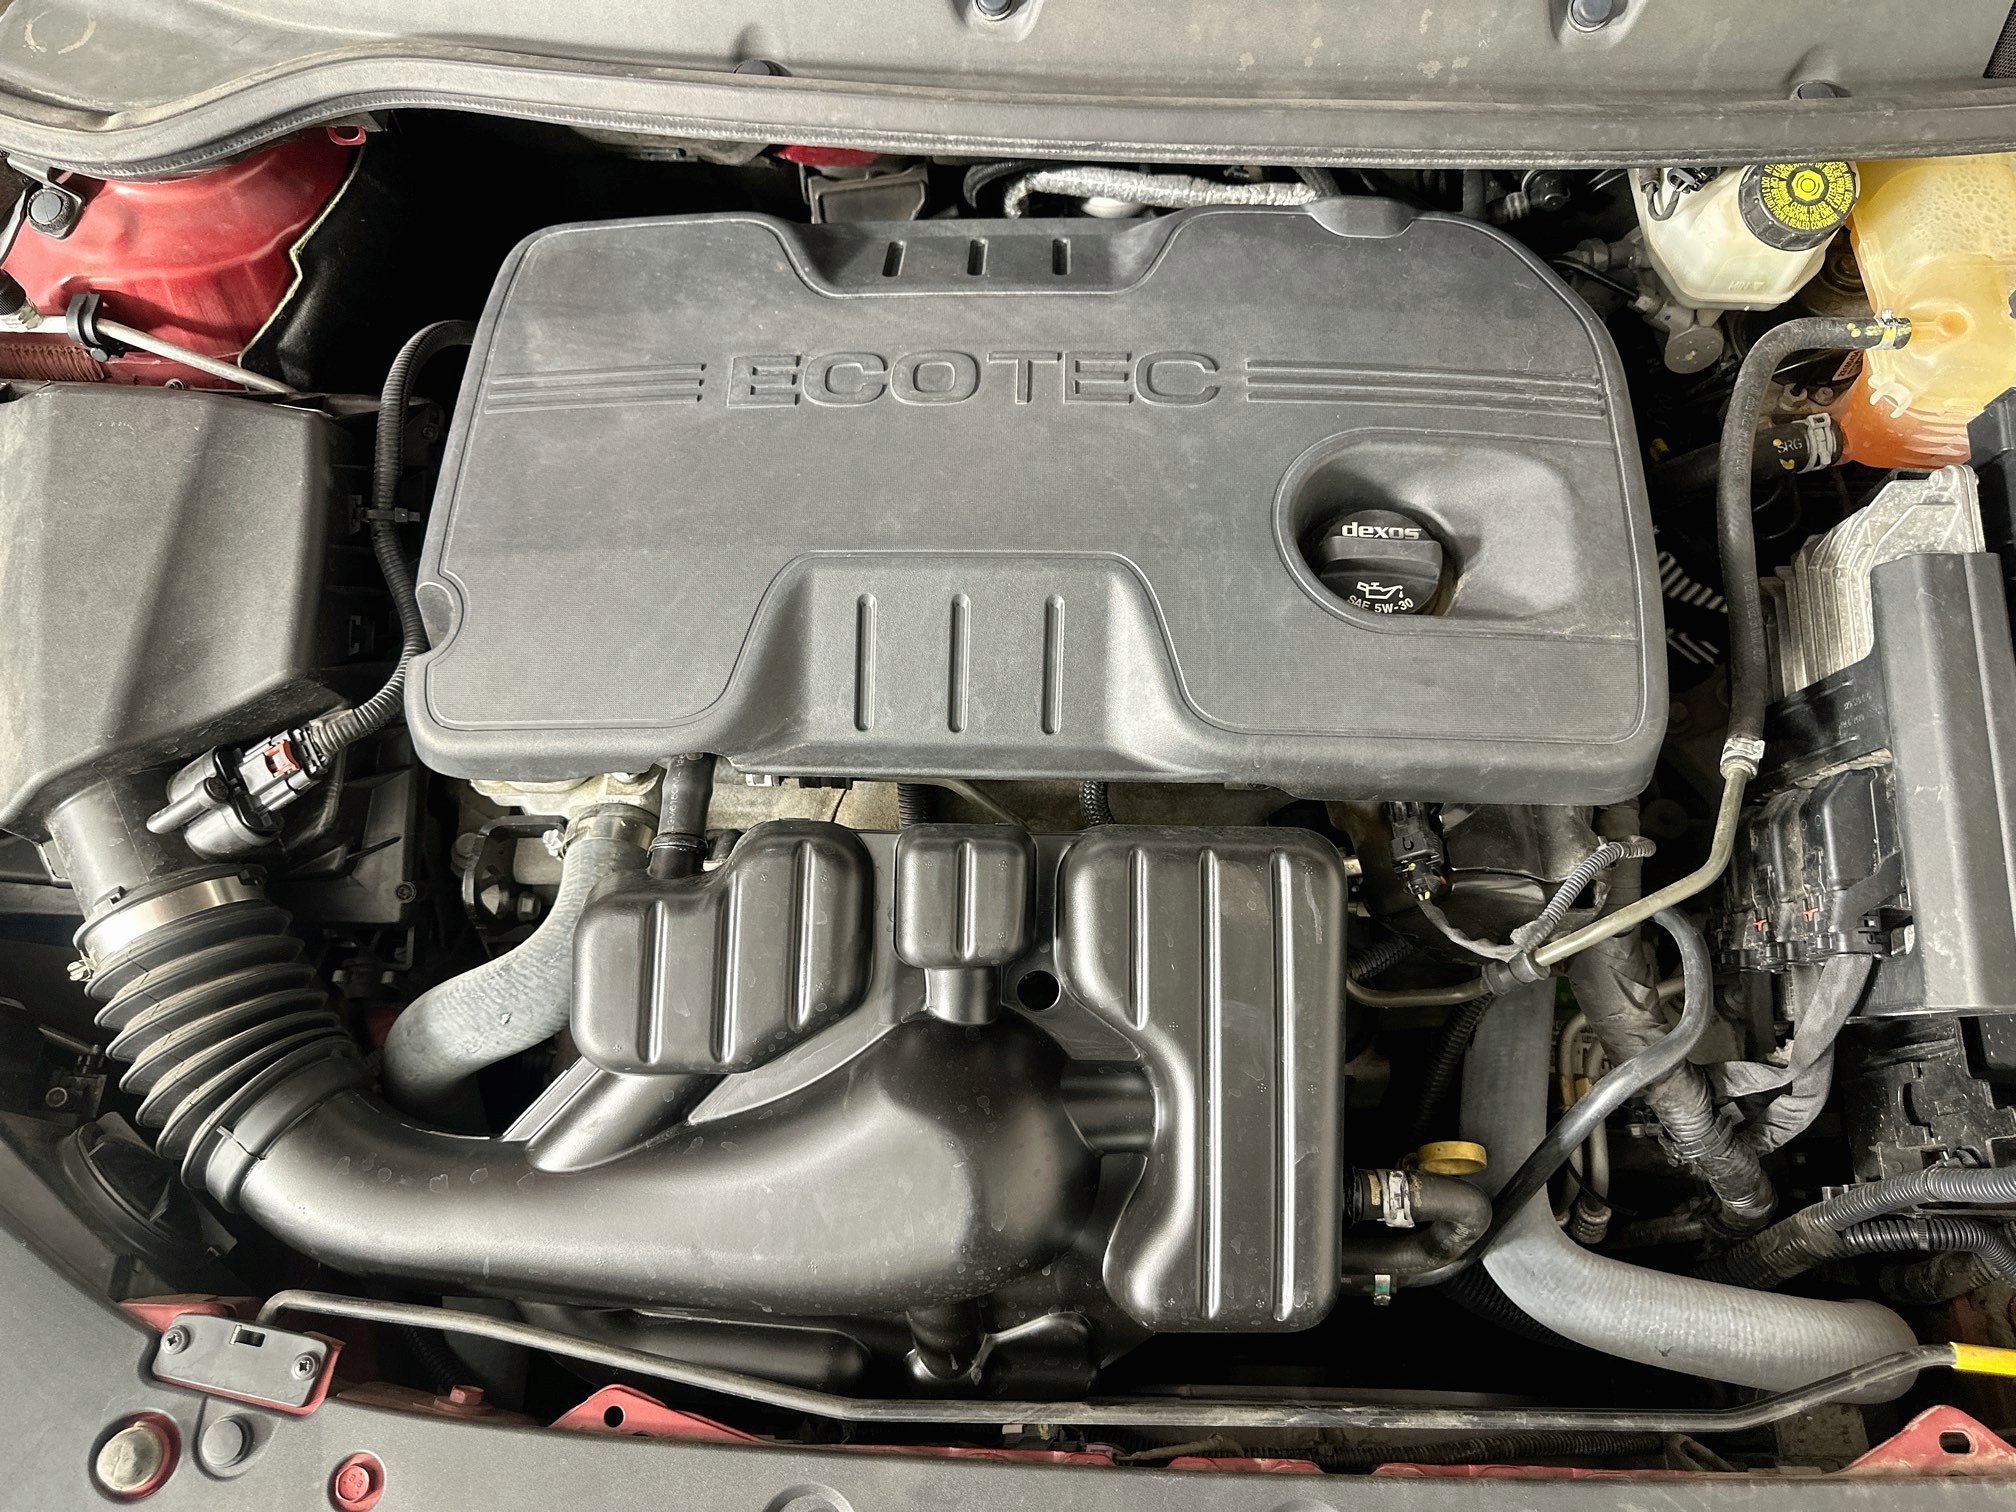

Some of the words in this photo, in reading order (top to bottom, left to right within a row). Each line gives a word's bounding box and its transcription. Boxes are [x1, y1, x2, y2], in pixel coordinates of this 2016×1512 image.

[1761, 176, 1770, 188] DOT
[1763, 193, 1776, 209] FLUID
[1790, 202, 1807, 214] CLEAN
[1809, 201, 1829, 214] FILLER
[1771, 205, 1786, 222] FROM
[1782, 205, 1809, 221] REMOVING
[1810, 212, 1820, 222] USE
[1820, 206, 1834, 218] ONLY
[1810, 213, 1840, 230] CONTAINER
[1788, 218, 1810, 230] SEALED
[727, 350, 1221, 408] ECOTEC
[1341, 521, 1421, 540] dexos
[1347, 595, 1371, 610] SAE
[1374, 598, 1414, 613] 5W-30
